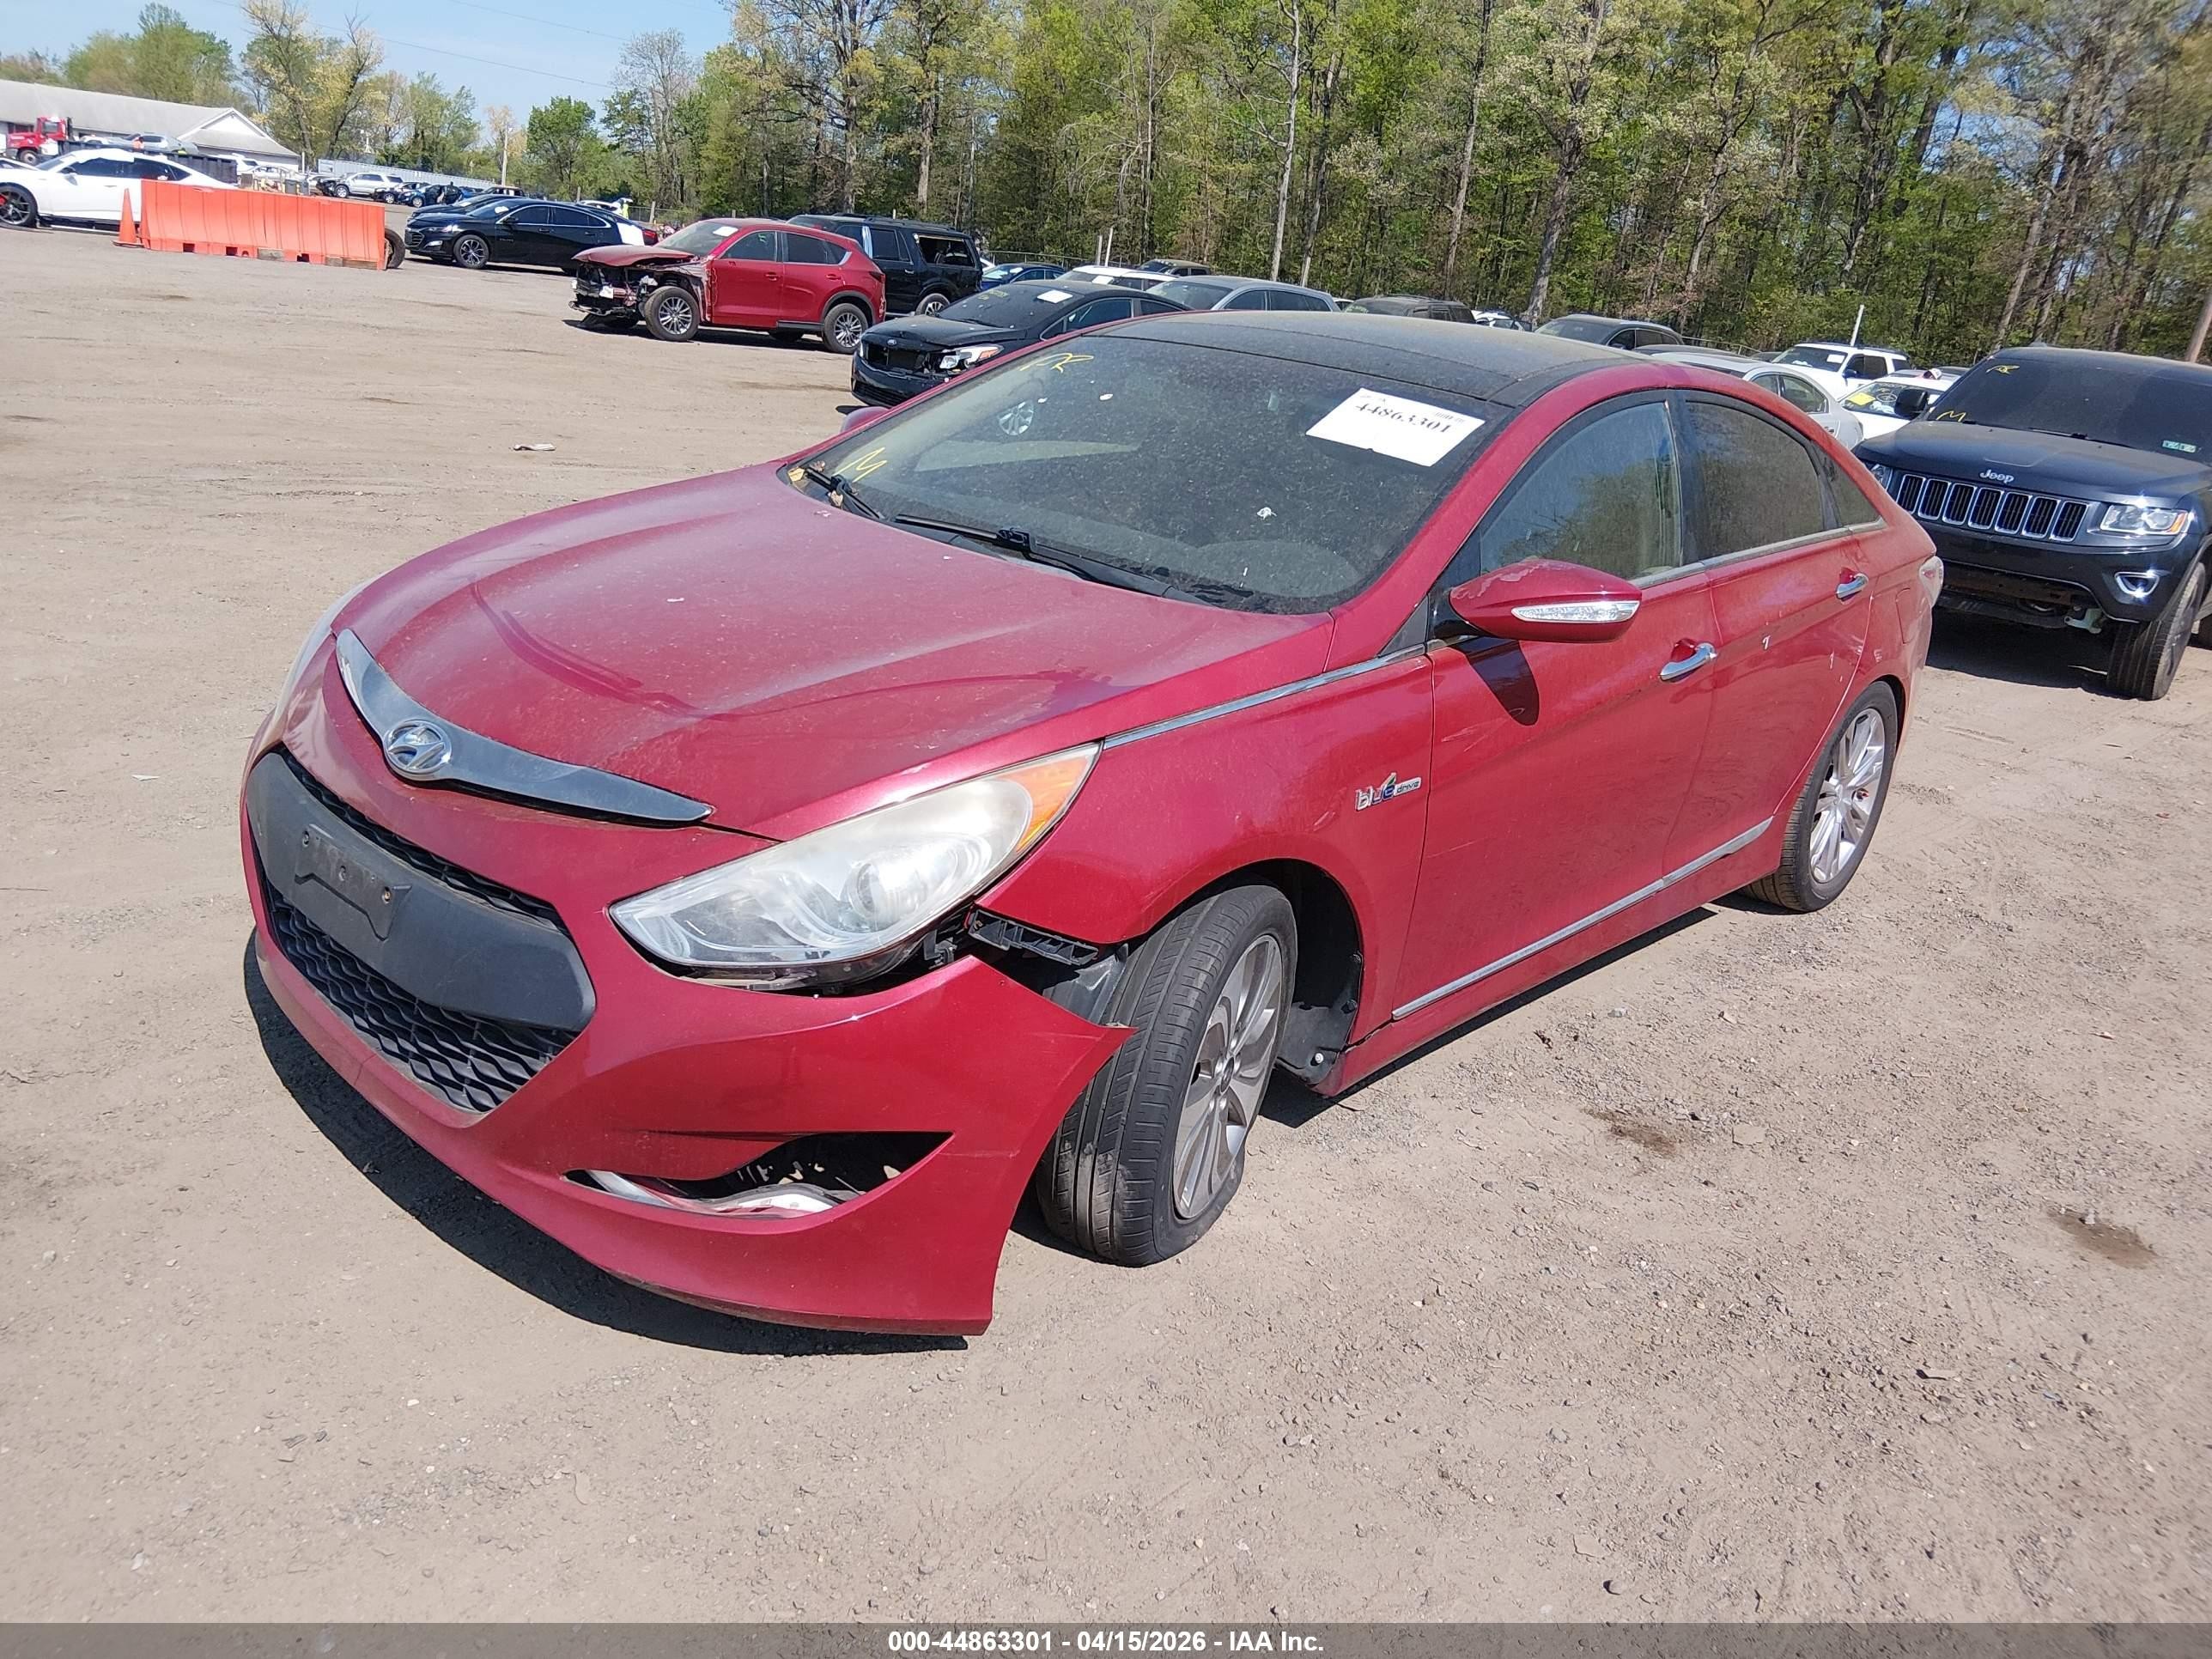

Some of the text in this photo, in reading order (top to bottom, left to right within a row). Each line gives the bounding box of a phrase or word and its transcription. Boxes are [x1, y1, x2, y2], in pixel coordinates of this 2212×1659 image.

[1356, 403, 1451, 433] 44863301
[1980, 470, 2014, 483] Jeep
[1356, 775, 1420, 811] blue drive
